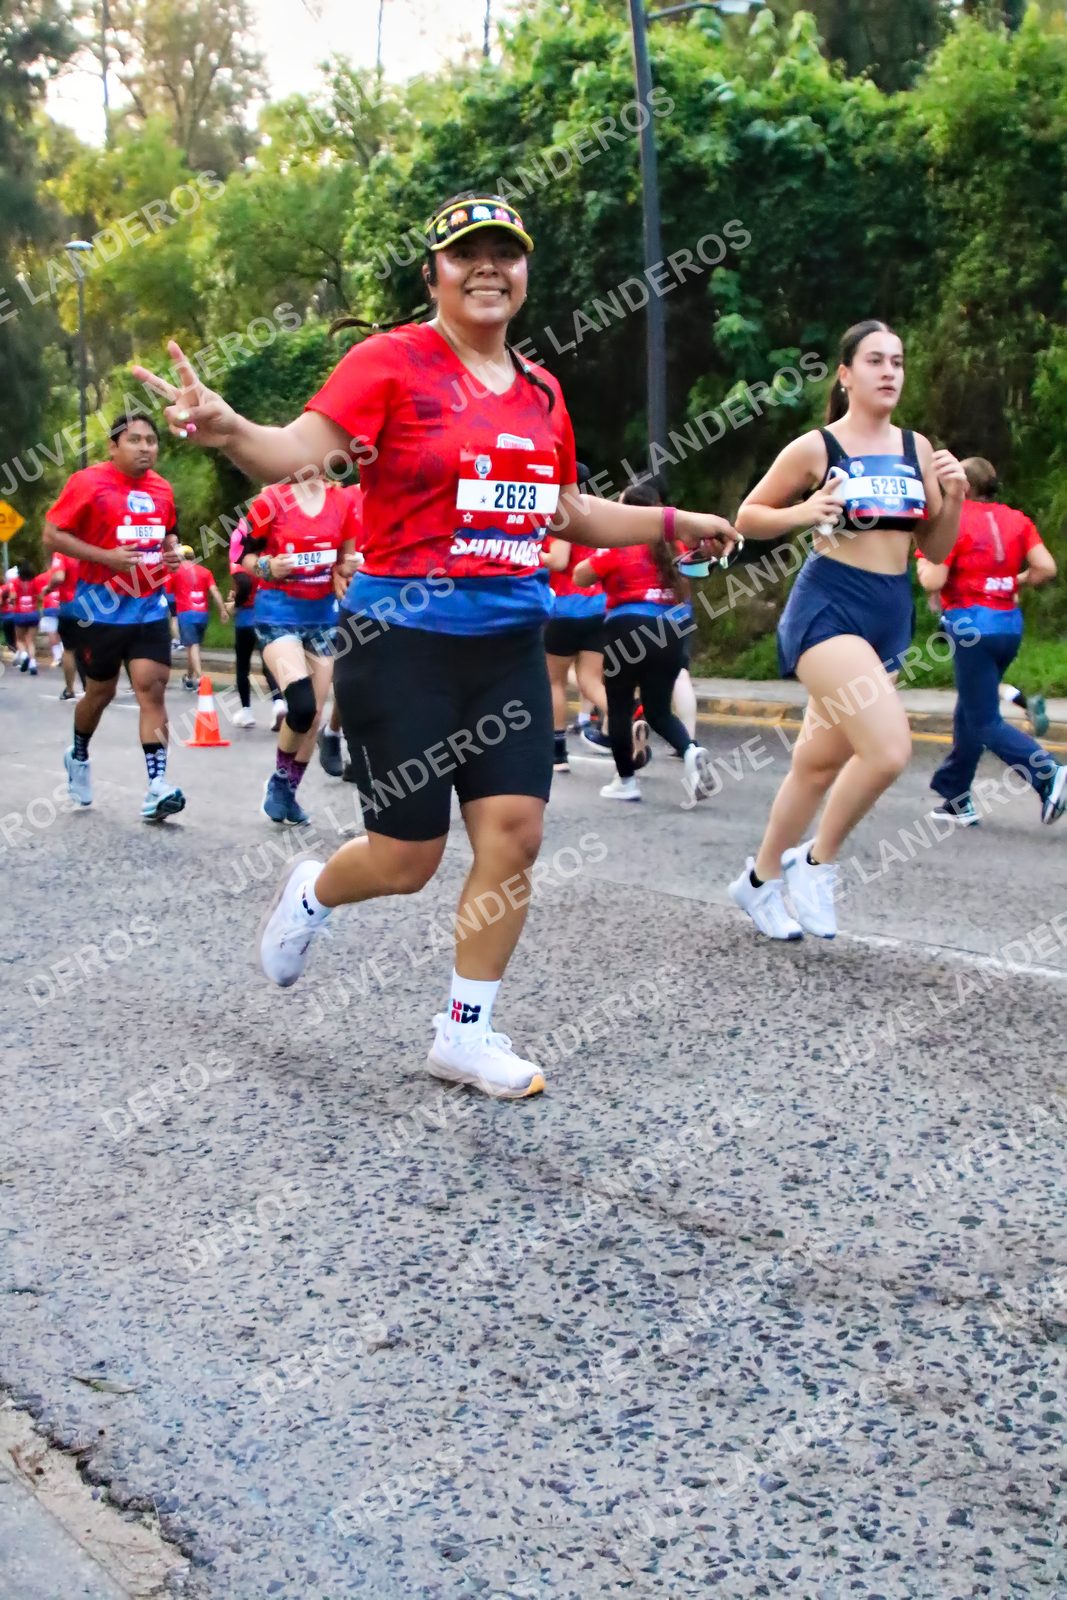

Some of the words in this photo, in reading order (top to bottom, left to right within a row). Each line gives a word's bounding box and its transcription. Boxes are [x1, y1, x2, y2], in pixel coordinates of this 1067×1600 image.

[870, 478, 908, 496] 5239
[494, 483, 536, 510] 2623
[135, 526, 154, 537] 1652
[297, 551, 321, 565] 2942
